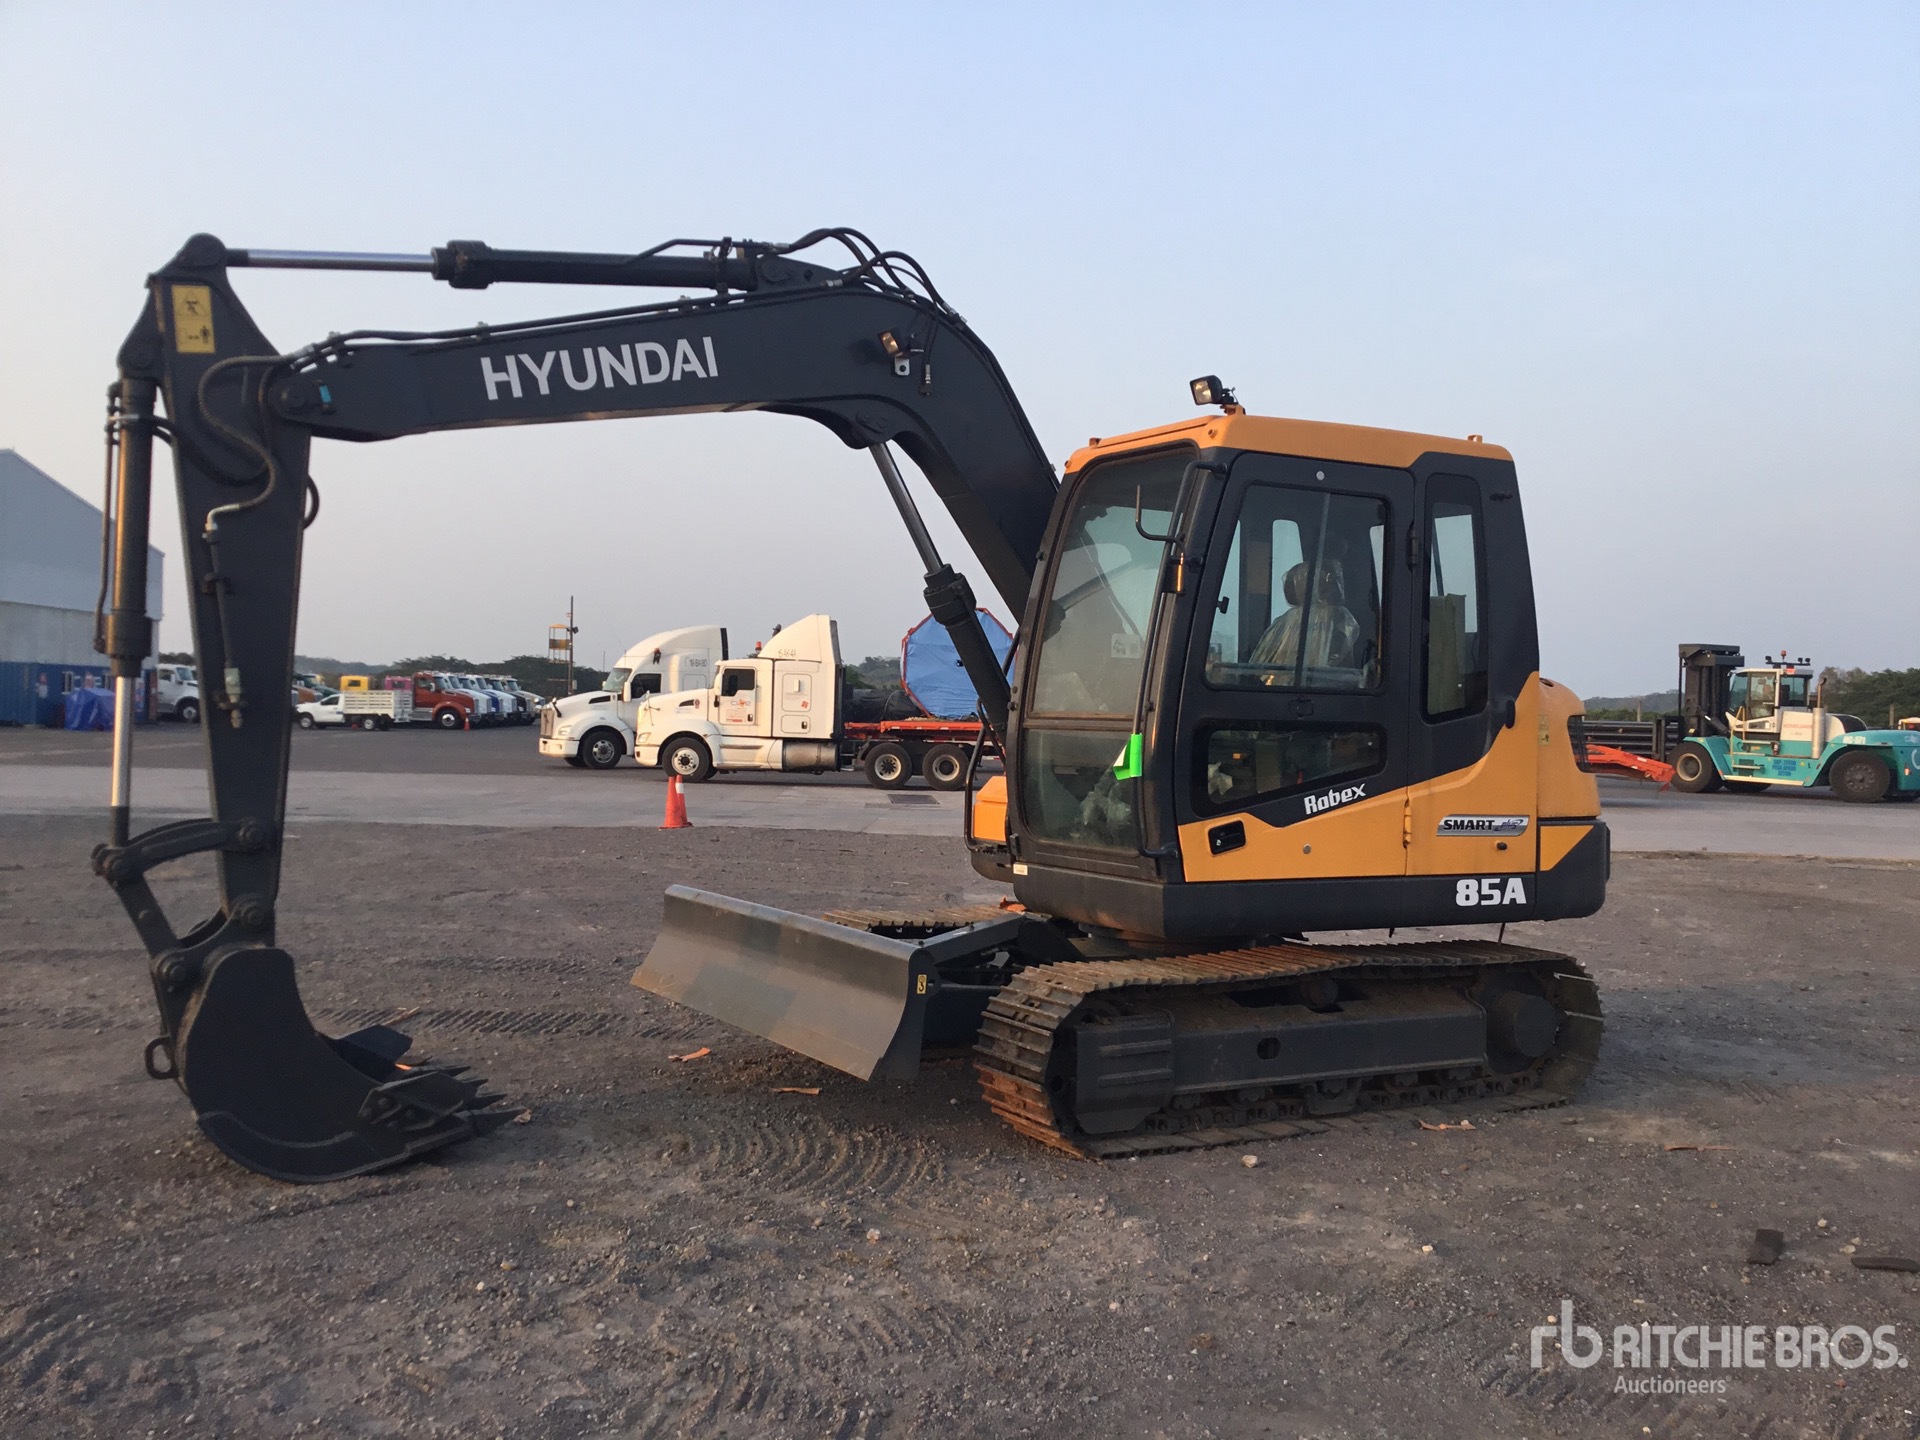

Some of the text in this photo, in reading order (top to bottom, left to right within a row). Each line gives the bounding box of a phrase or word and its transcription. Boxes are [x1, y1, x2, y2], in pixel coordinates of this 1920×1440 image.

[480, 336, 719, 400] HYUNDAI
[1304, 783, 1367, 815] Robex
[1443, 819, 1495, 831] SMART
[1456, 877, 1527, 907] 85A
